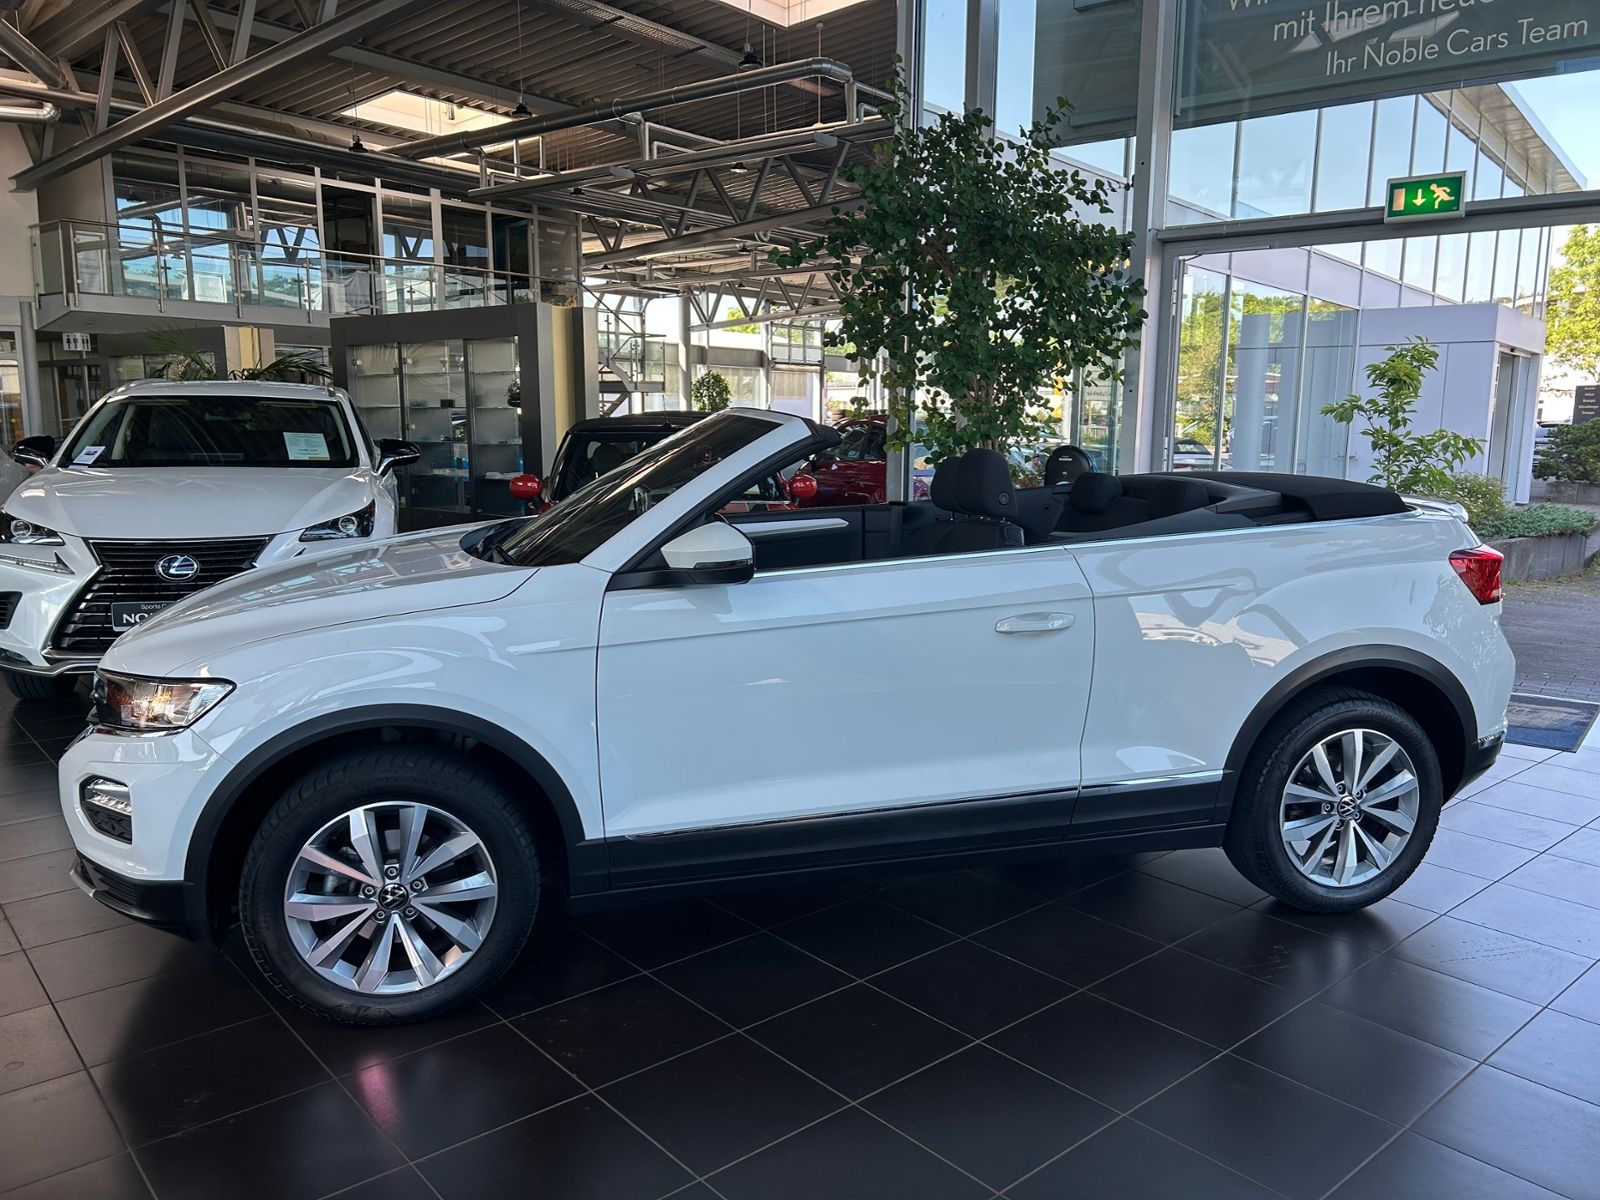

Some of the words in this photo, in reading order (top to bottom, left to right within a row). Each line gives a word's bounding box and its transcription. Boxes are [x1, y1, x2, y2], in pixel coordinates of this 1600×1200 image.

[1273, 10, 1316, 41] mit
[1325, 0, 1409, 32] Ihrem
[1326, 50, 1357, 76] Ihr
[1363, 35, 1439, 70] Noble
[1446, 28, 1509, 55] Cars
[1517, 17, 1589, 45] Team
